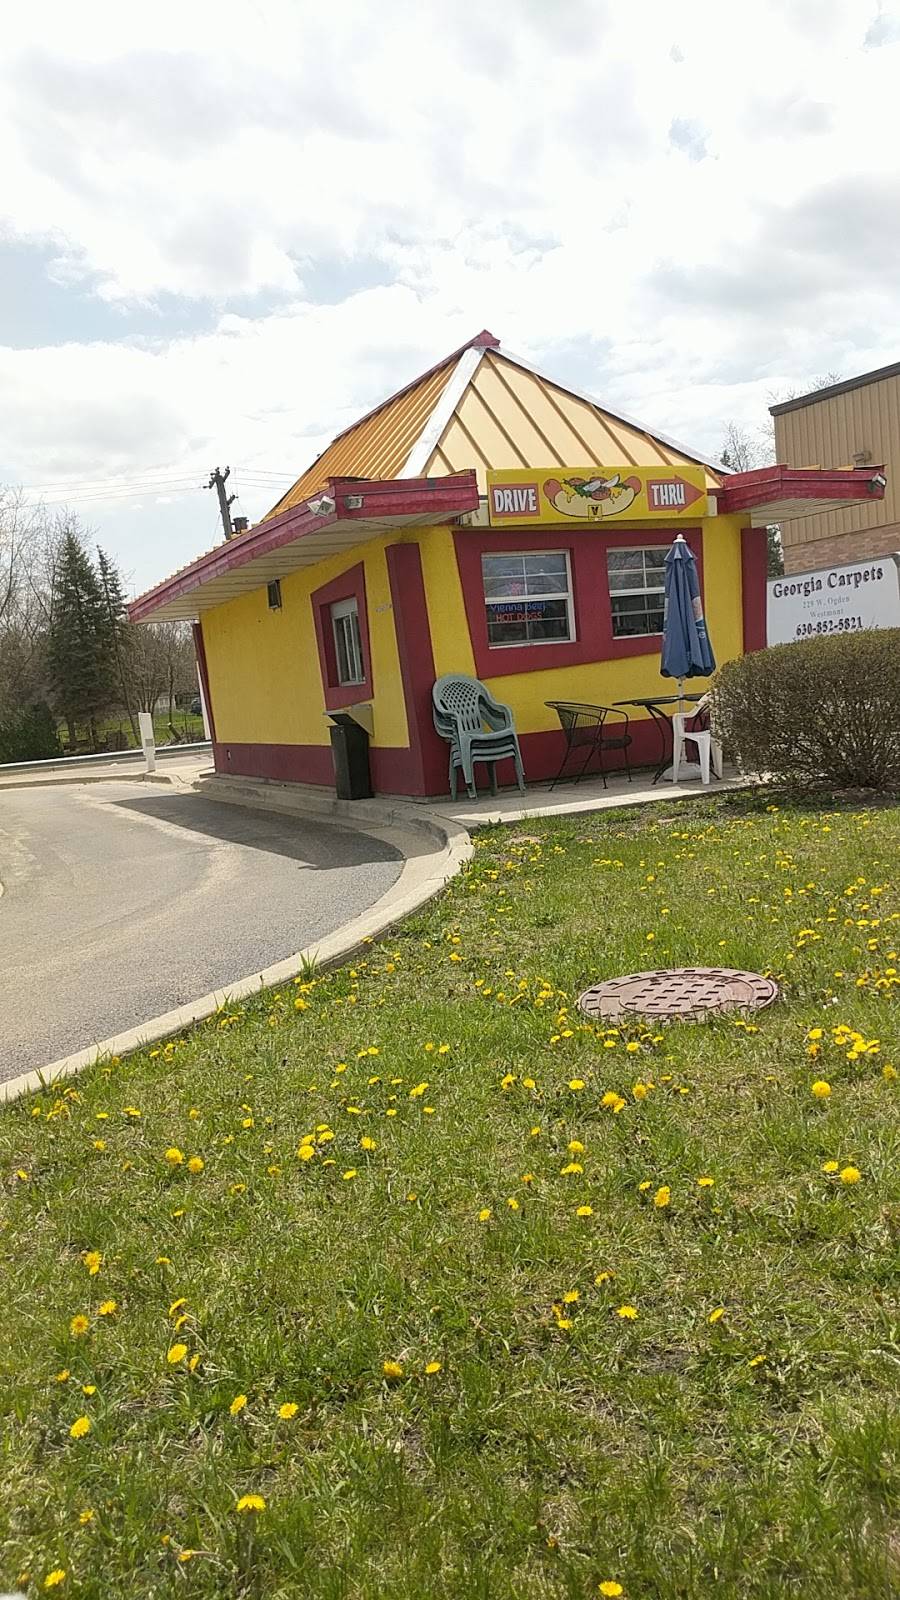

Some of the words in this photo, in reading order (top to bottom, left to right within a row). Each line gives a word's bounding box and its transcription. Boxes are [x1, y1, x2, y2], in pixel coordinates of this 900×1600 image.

[493, 488, 537, 513] DRIVE
[651, 483, 686, 506] THRU
[773, 576, 822, 598] Georgia
[827, 566, 884, 589] Carpets
[496, 613, 514, 623] HOT
[810, 608, 844, 618] Westmont
[796, 616, 863, 636] 630-852-5821
